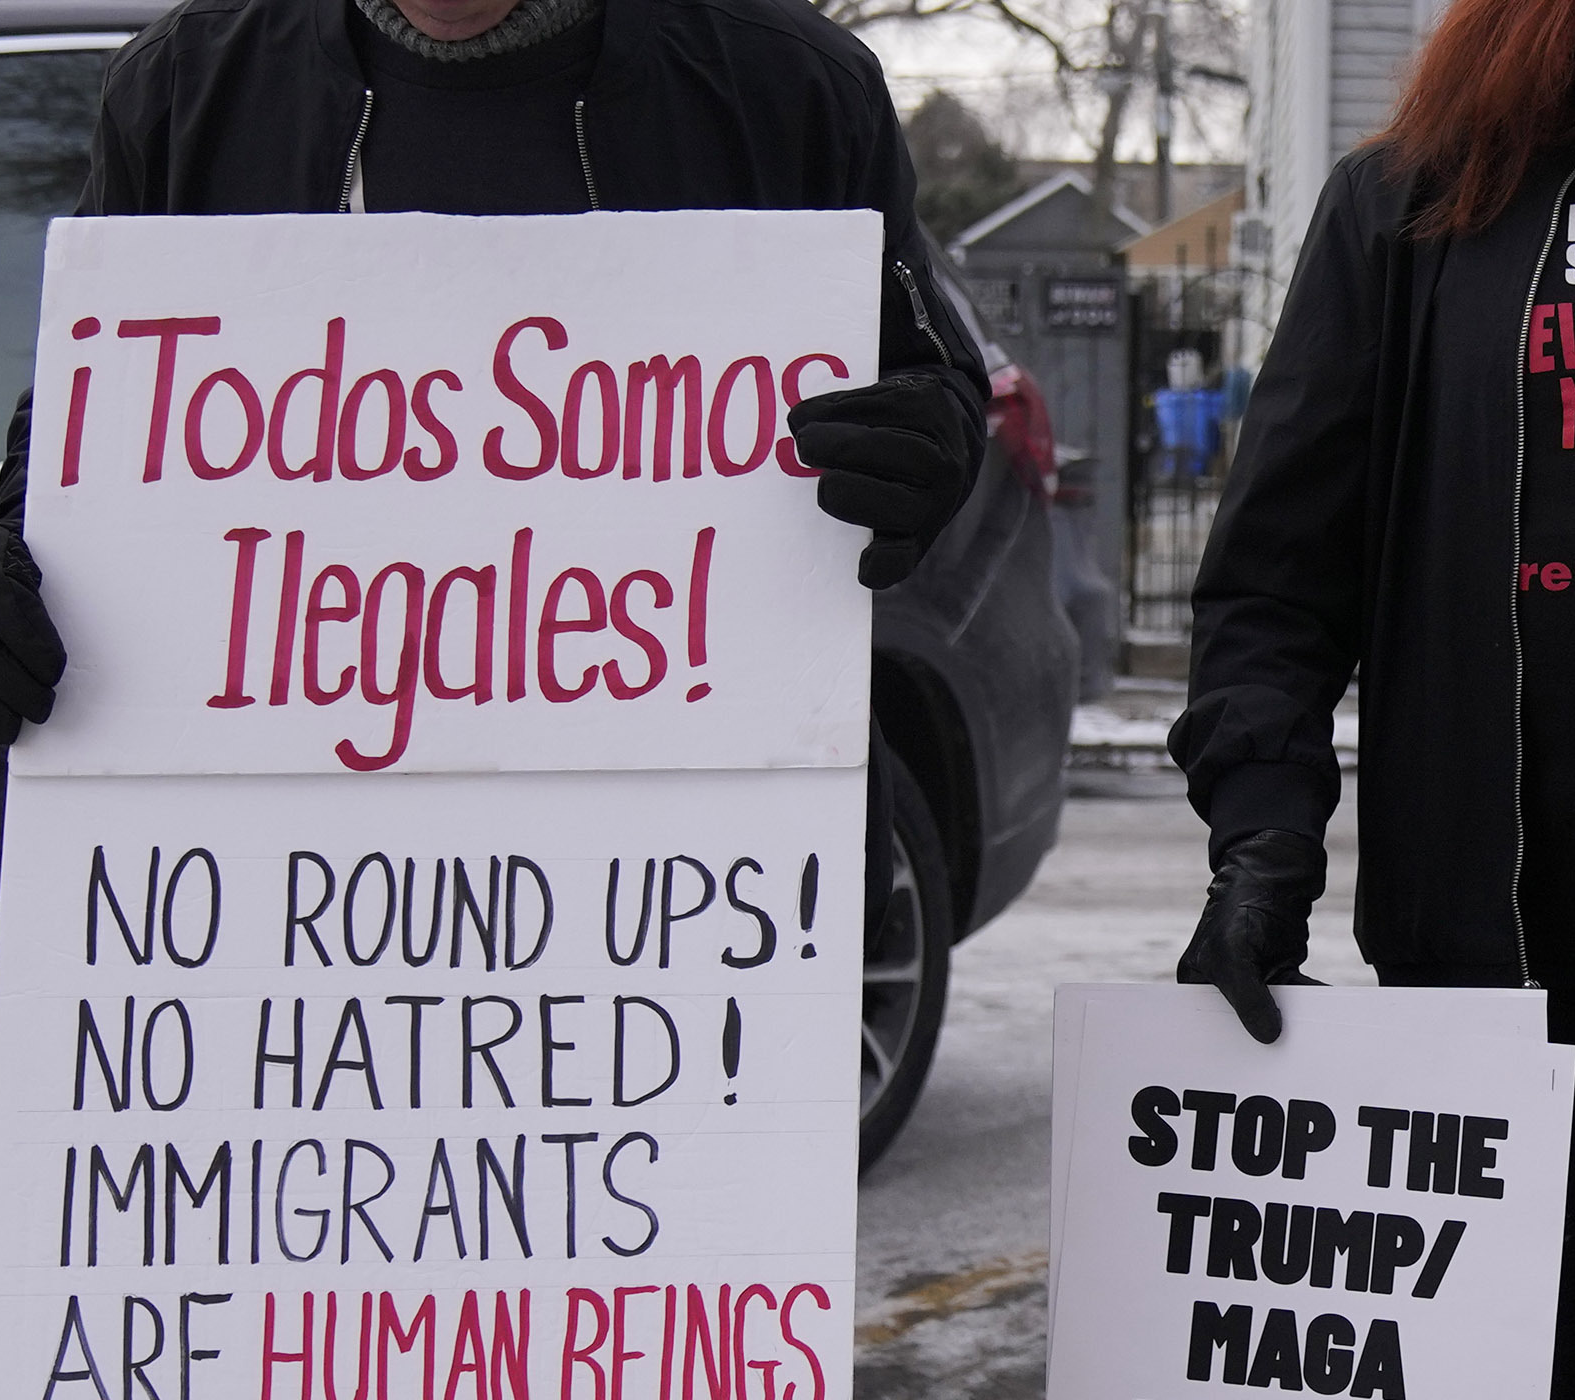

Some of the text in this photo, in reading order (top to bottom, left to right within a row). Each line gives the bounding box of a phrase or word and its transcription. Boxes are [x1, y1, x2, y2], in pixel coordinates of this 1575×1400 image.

[482, 315, 850, 483] Somos
[208, 526, 717, 771] Ilegales!
[87, 845, 819, 972] NO ROUND UPS!
[73, 996, 195, 1113] NO
[59, 1131, 660, 1268] IMMIGRANTS
[1127, 1085, 1509, 1200] STOP THE
[1156, 1191, 1468, 1299] TRUMP/
